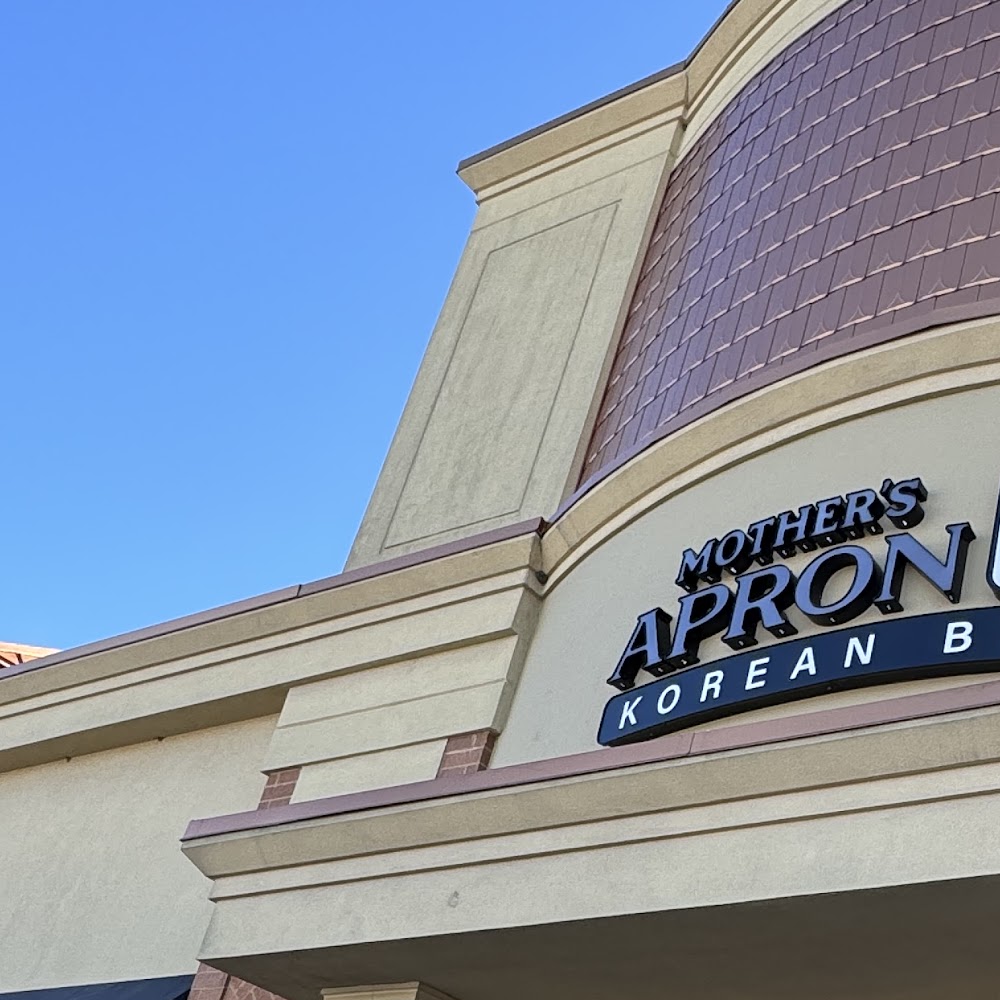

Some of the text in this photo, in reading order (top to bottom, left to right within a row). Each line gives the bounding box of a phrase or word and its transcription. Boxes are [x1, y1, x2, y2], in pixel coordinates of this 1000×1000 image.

[677, 478, 927, 590] MOTHER'S
[607, 521, 976, 688] APRON
[618, 633, 876, 729] KOREAN
